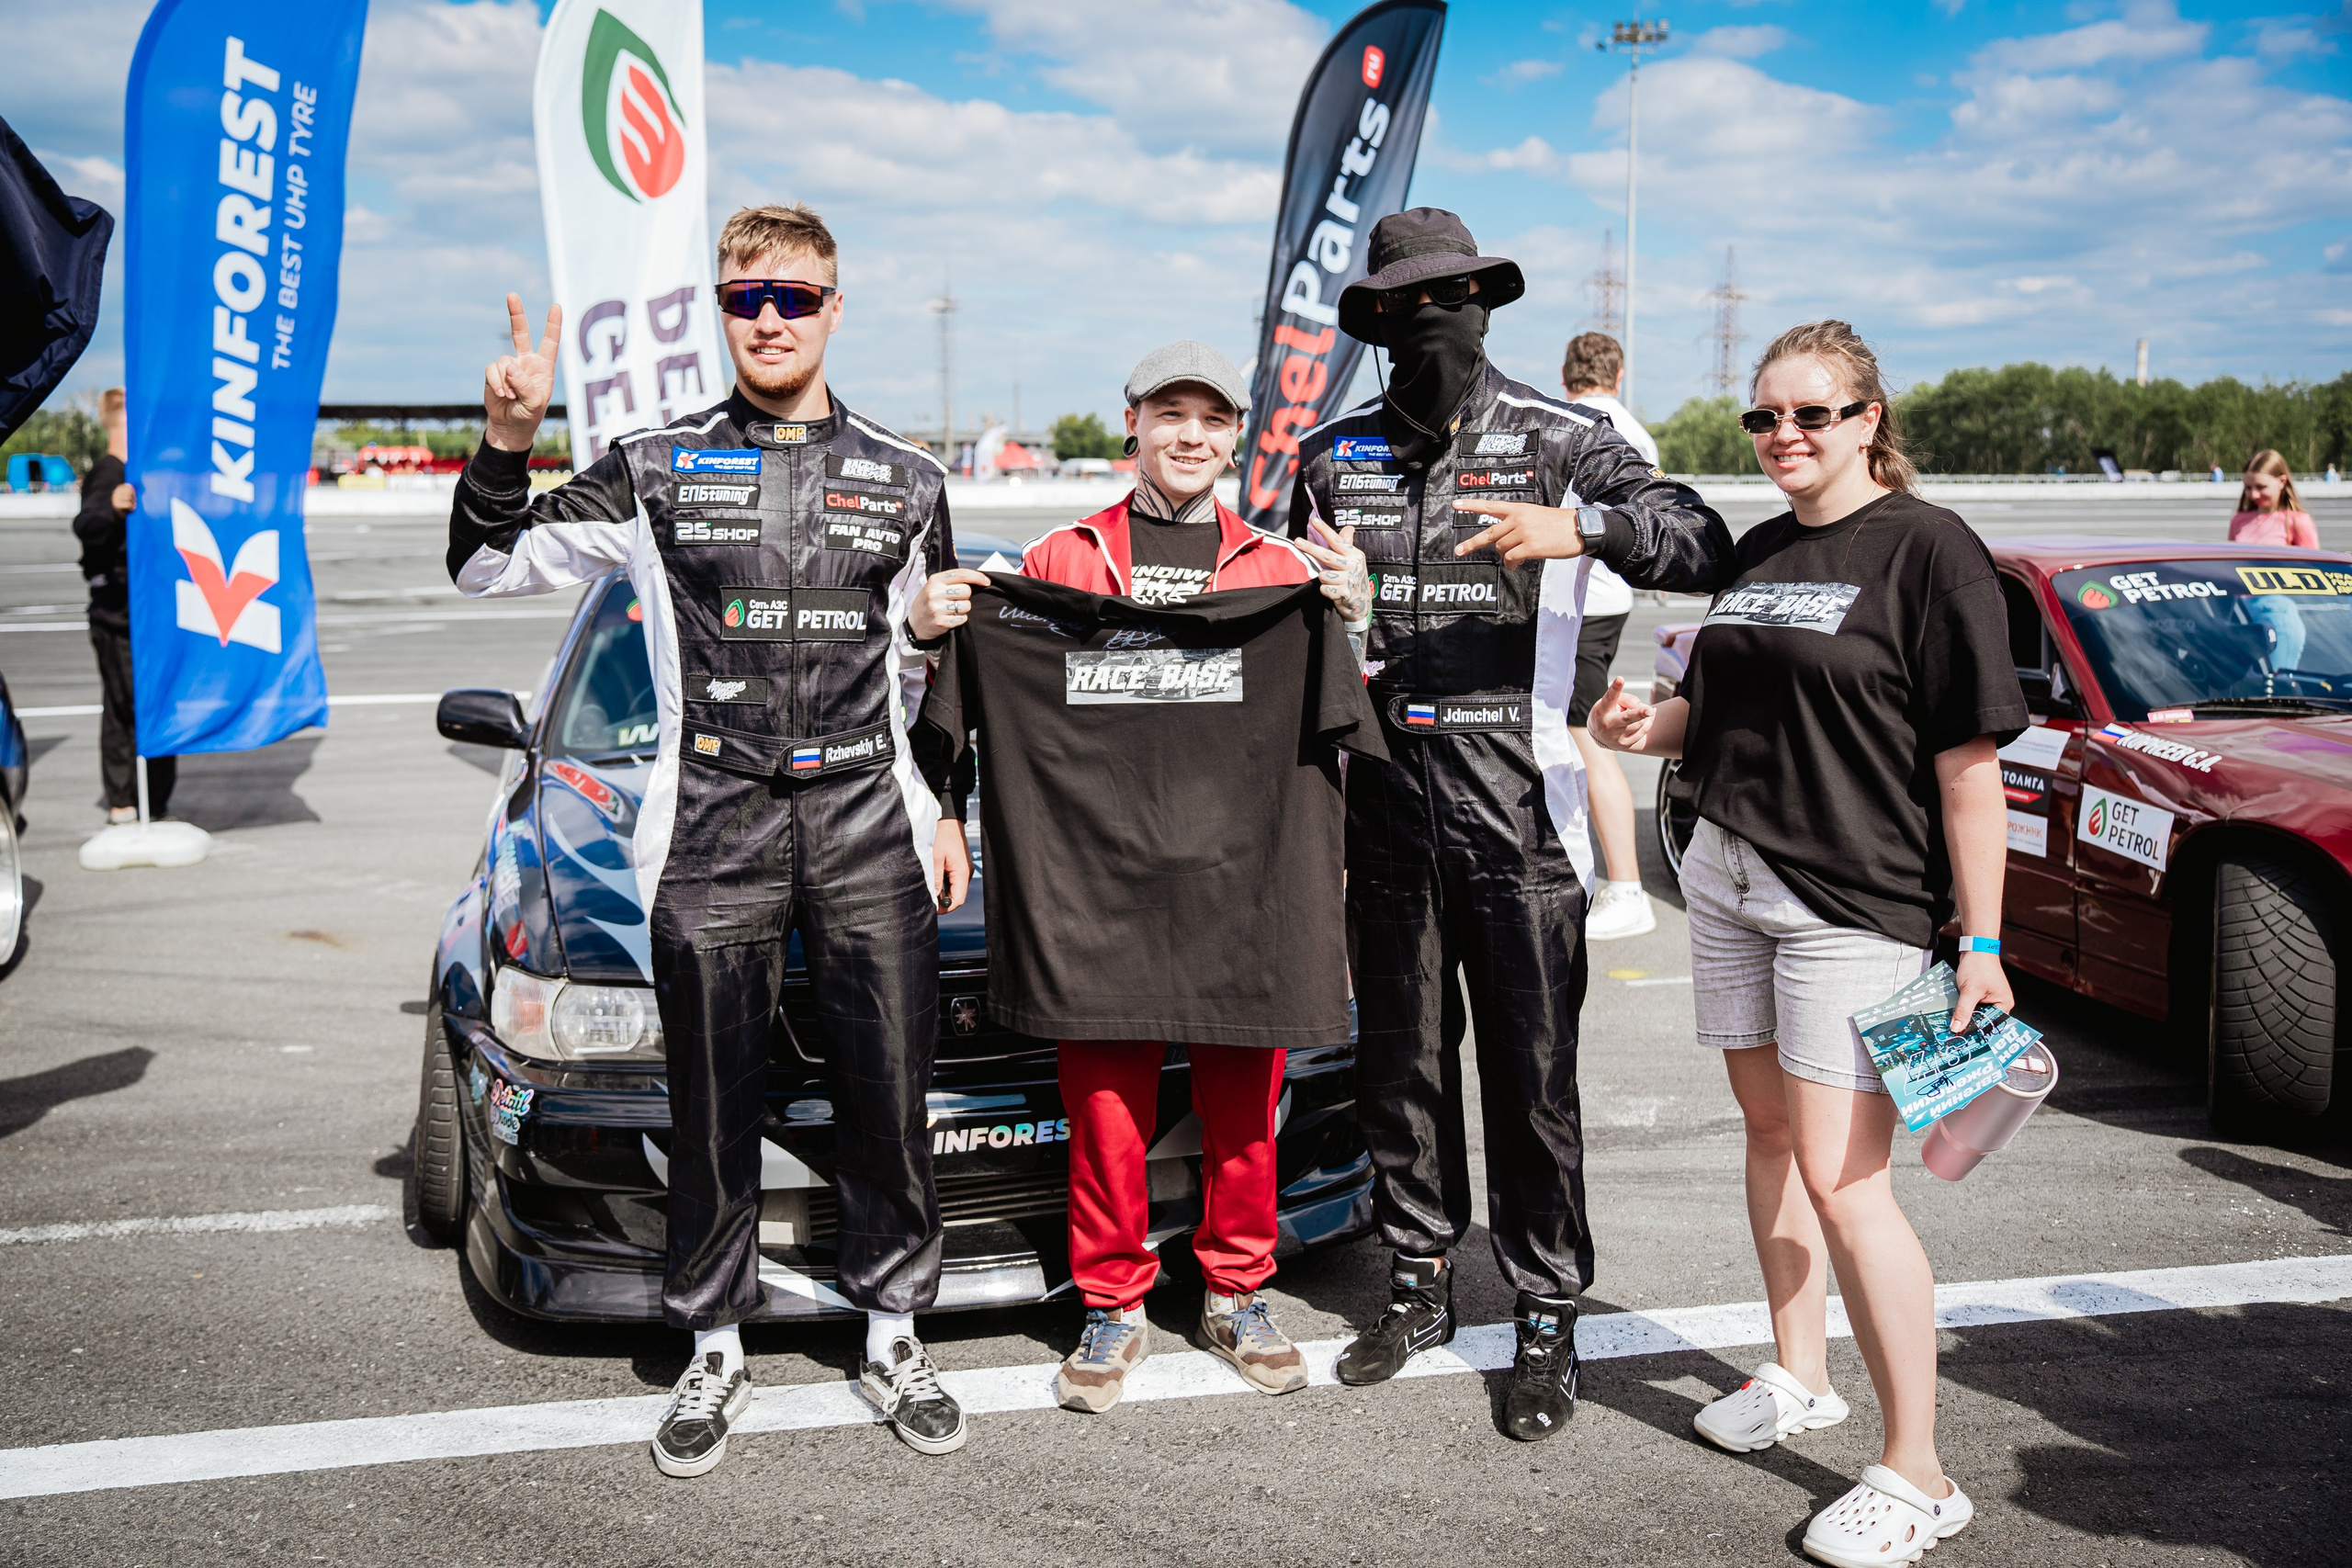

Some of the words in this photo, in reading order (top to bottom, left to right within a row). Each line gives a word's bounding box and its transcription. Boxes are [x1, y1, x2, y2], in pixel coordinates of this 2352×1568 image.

[289, 81, 317, 157] TYRE
[284, 164, 309, 231] UHP
[209, 34, 281, 503] KINFOREST
[278, 231, 303, 310] BEST
[271, 313, 297, 370] THE
[775, 426, 805, 442] OMP
[1354, 445, 1391, 453] KINFOR
[696, 457, 760, 467] KINFOREST
[1459, 472, 1527, 486] ChelParts
[826, 493, 898, 513] ChelParts
[829, 524, 862, 537] FAN
[865, 527, 901, 544] AVTO
[853, 537, 883, 551] PRO
[1380, 584, 1416, 603] GET
[1421, 583, 1498, 603] PETROL
[2109, 571, 2160, 591] GET
[2121, 581, 2228, 604] PETROL
[749, 599, 769, 610] Сеть
[770, 599, 788, 610] АЗС
[1711, 593, 1775, 615] RACE
[1770, 594, 1849, 620] BASE
[746, 610, 788, 629] GET
[797, 609, 867, 630] PETROL
[1069, 664, 1150, 692] RACE
[1157, 663, 1240, 690] BASE
[1442, 707, 1503, 724] Jdmchel
[1508, 706, 1521, 722] V.
[695, 736, 720, 752] OMP
[825, 738, 874, 763] Rzhevskiy
[875, 734, 887, 750] E.
[2116, 732, 2196, 762] КОРНЕЕВ
[2111, 801, 2140, 826] GET
[2007, 821, 2042, 840] РОЖНИК
[2108, 824, 2158, 861] PETROL
[1997, 1030, 2033, 1064] Ден
[1901, 1061, 1995, 1120] Ржевский
[1929, 1069, 2003, 1119] Евгений
[933, 1117, 1071, 1155] INFORES
